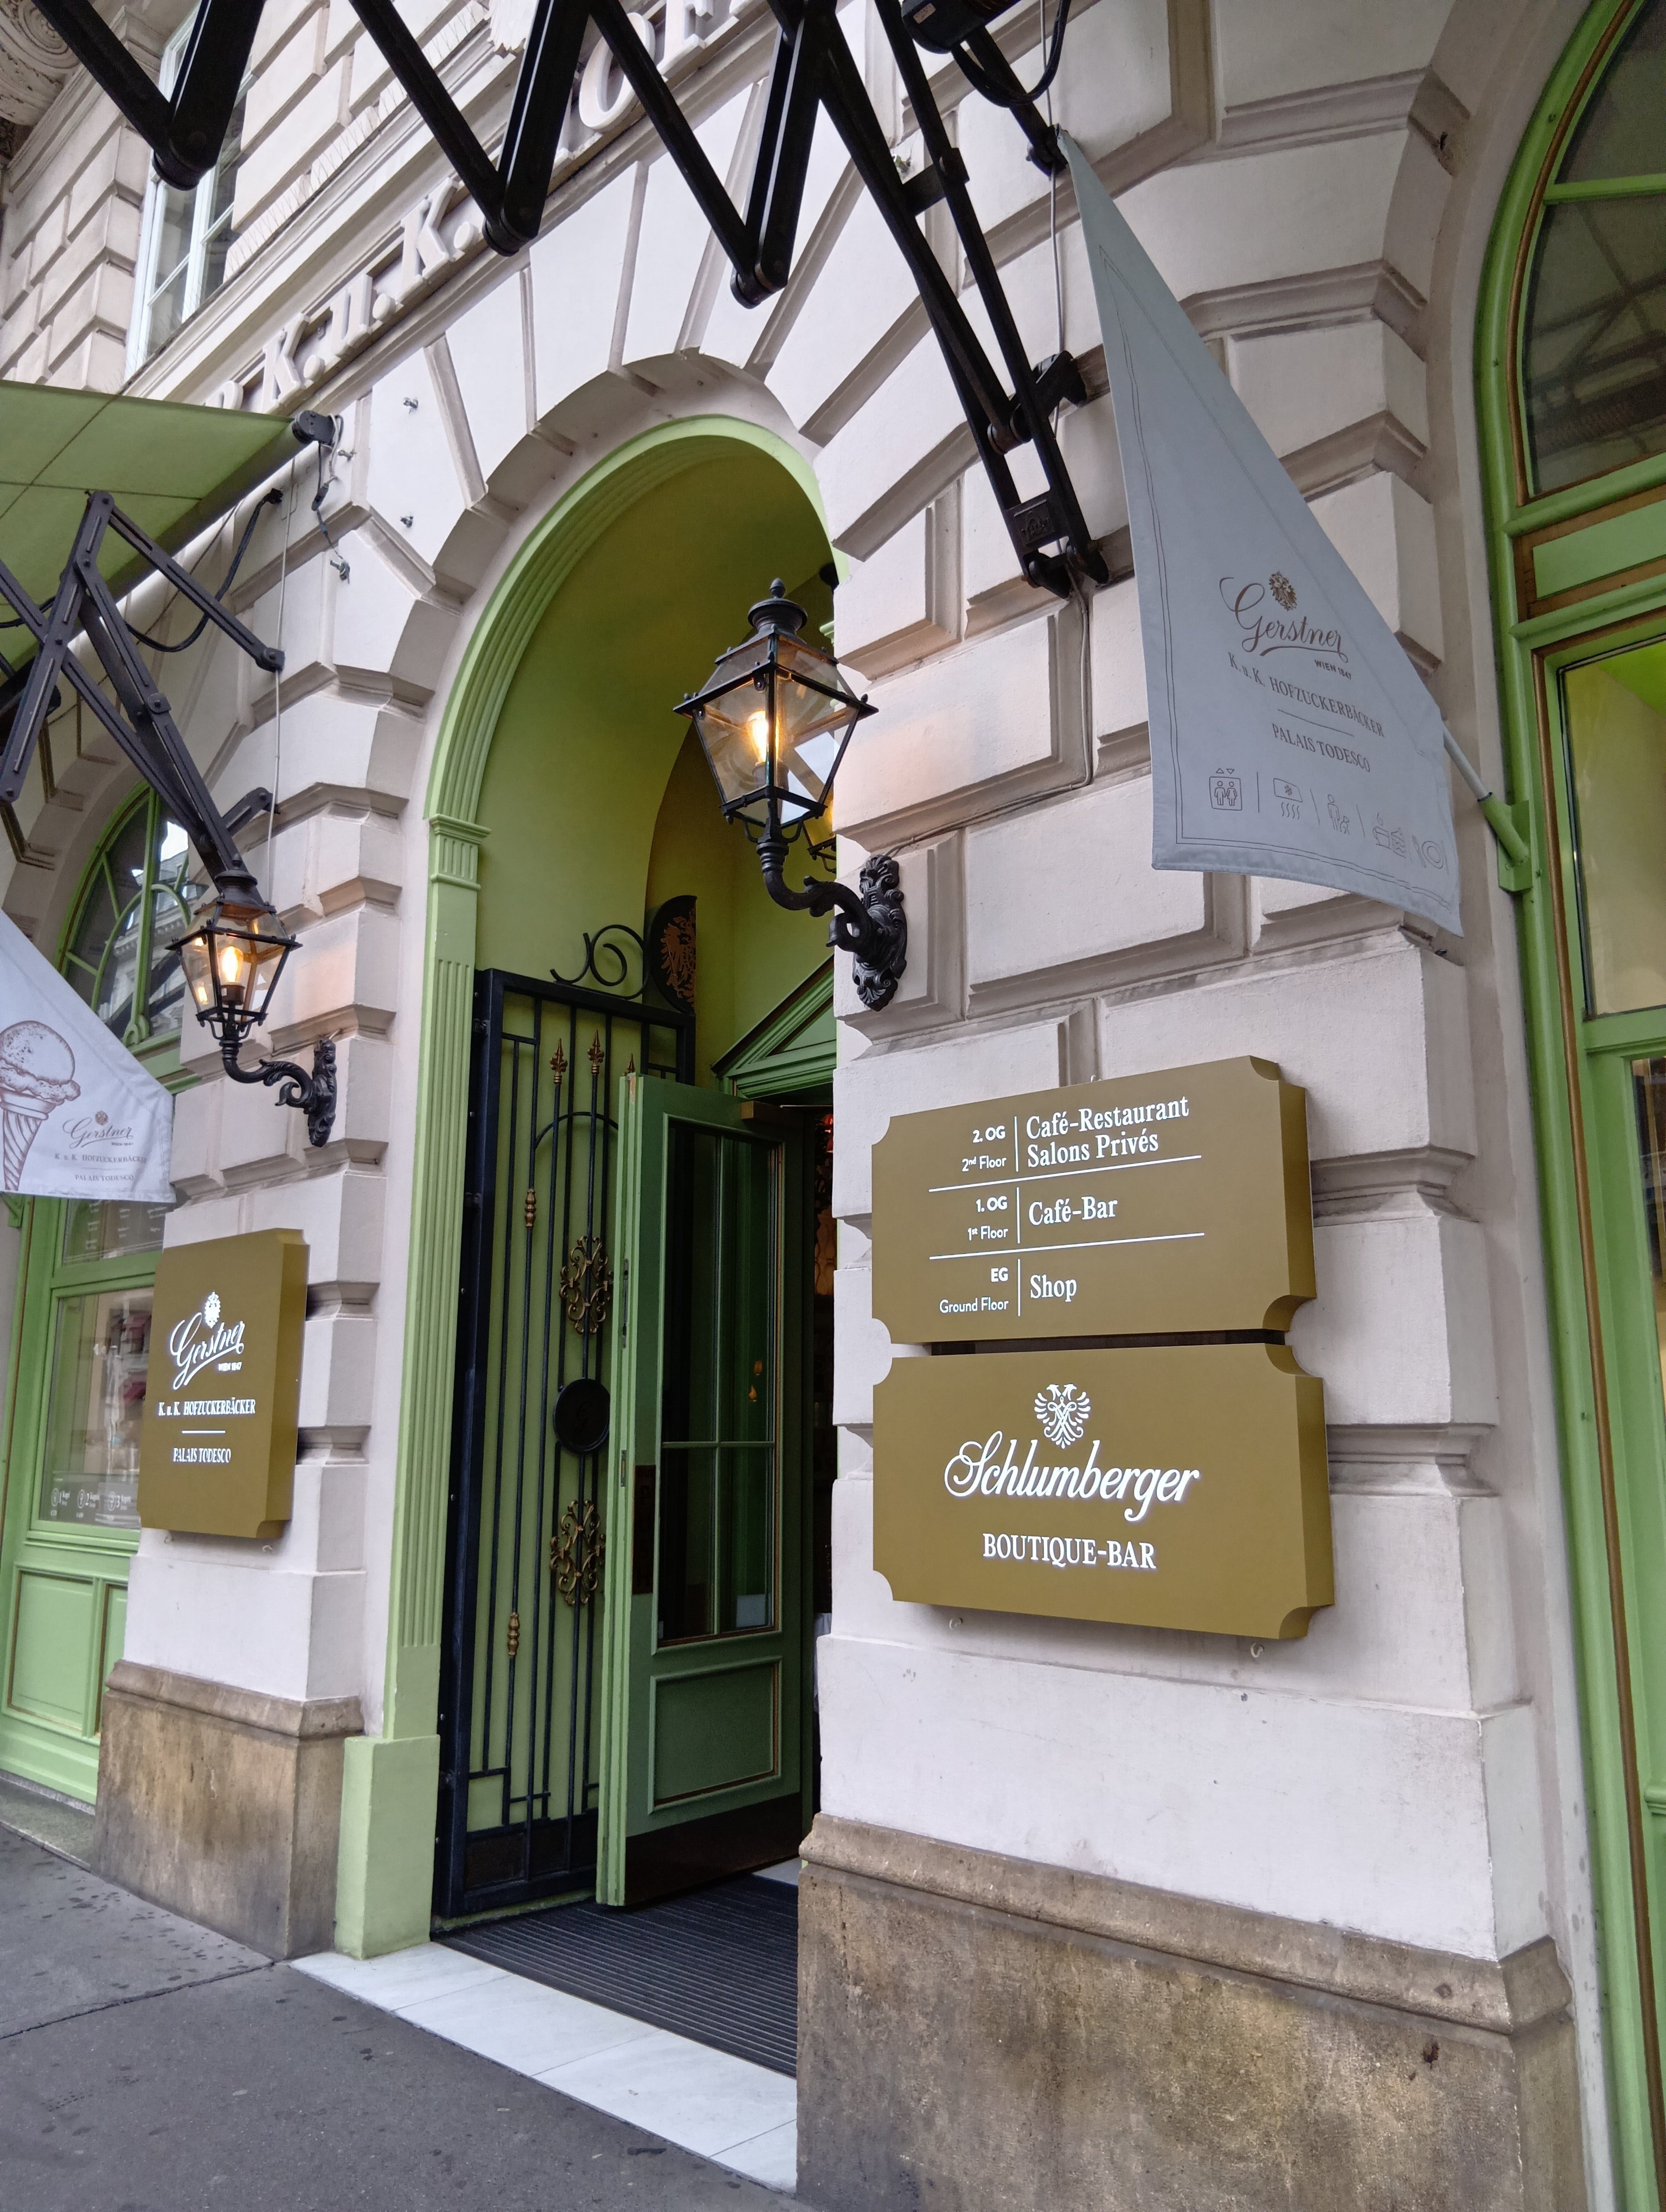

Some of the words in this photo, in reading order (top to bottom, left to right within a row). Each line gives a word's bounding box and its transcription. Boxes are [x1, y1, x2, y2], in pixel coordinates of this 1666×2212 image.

[1219, 577, 1348, 664] Gerstner
[1315, 658, 1337, 673] WIEN
[1338, 667, 1351, 680] 1847
[1228, 652, 1241, 672] K.
[1242, 665, 1252, 679] u.
[1252, 667, 1265, 687] K.
[1269, 676, 1385, 738] HOFZUCKERBÄCKER
[1272, 723, 1316, 753] PALAIS
[1317, 740, 1370, 773] TODESCO
[1026, 1096, 1189, 1140] Café-Restaurant
[62, 1117, 134, 1149] Gerstner
[972, 1129, 983, 1143] 2.
[985, 1125, 1005, 1141] OG
[1027, 1141, 1090, 1168] Salons
[1095, 1128, 1158, 1159] Privés
[962, 1156, 977, 1172] 2nd
[979, 1155, 1007, 1170] Floor
[976, 1199, 984, 1213] 1.
[987, 1195, 1008, 1212] OG
[1029, 1195, 1118, 1225] Café-Bar
[967, 1227, 978, 1241] 1st
[981, 1225, 1009, 1240] Floor
[990, 1267, 1009, 1283] EG
[1030, 1274, 1078, 1302] Shop
[939, 1297, 978, 1314] Ground
[981, 1296, 1009, 1311] Floor
[170, 1311, 245, 1390] Gerstner
[183, 1397, 256, 1416] HOFZUCKERBÄCKER
[173, 1448, 197, 1462] PALAIS
[198, 1448, 232, 1463] TODESCO
[944, 1430, 1200, 1522] Schlumberger
[982, 1533, 1157, 1569] BOUTIQUE-BAR
